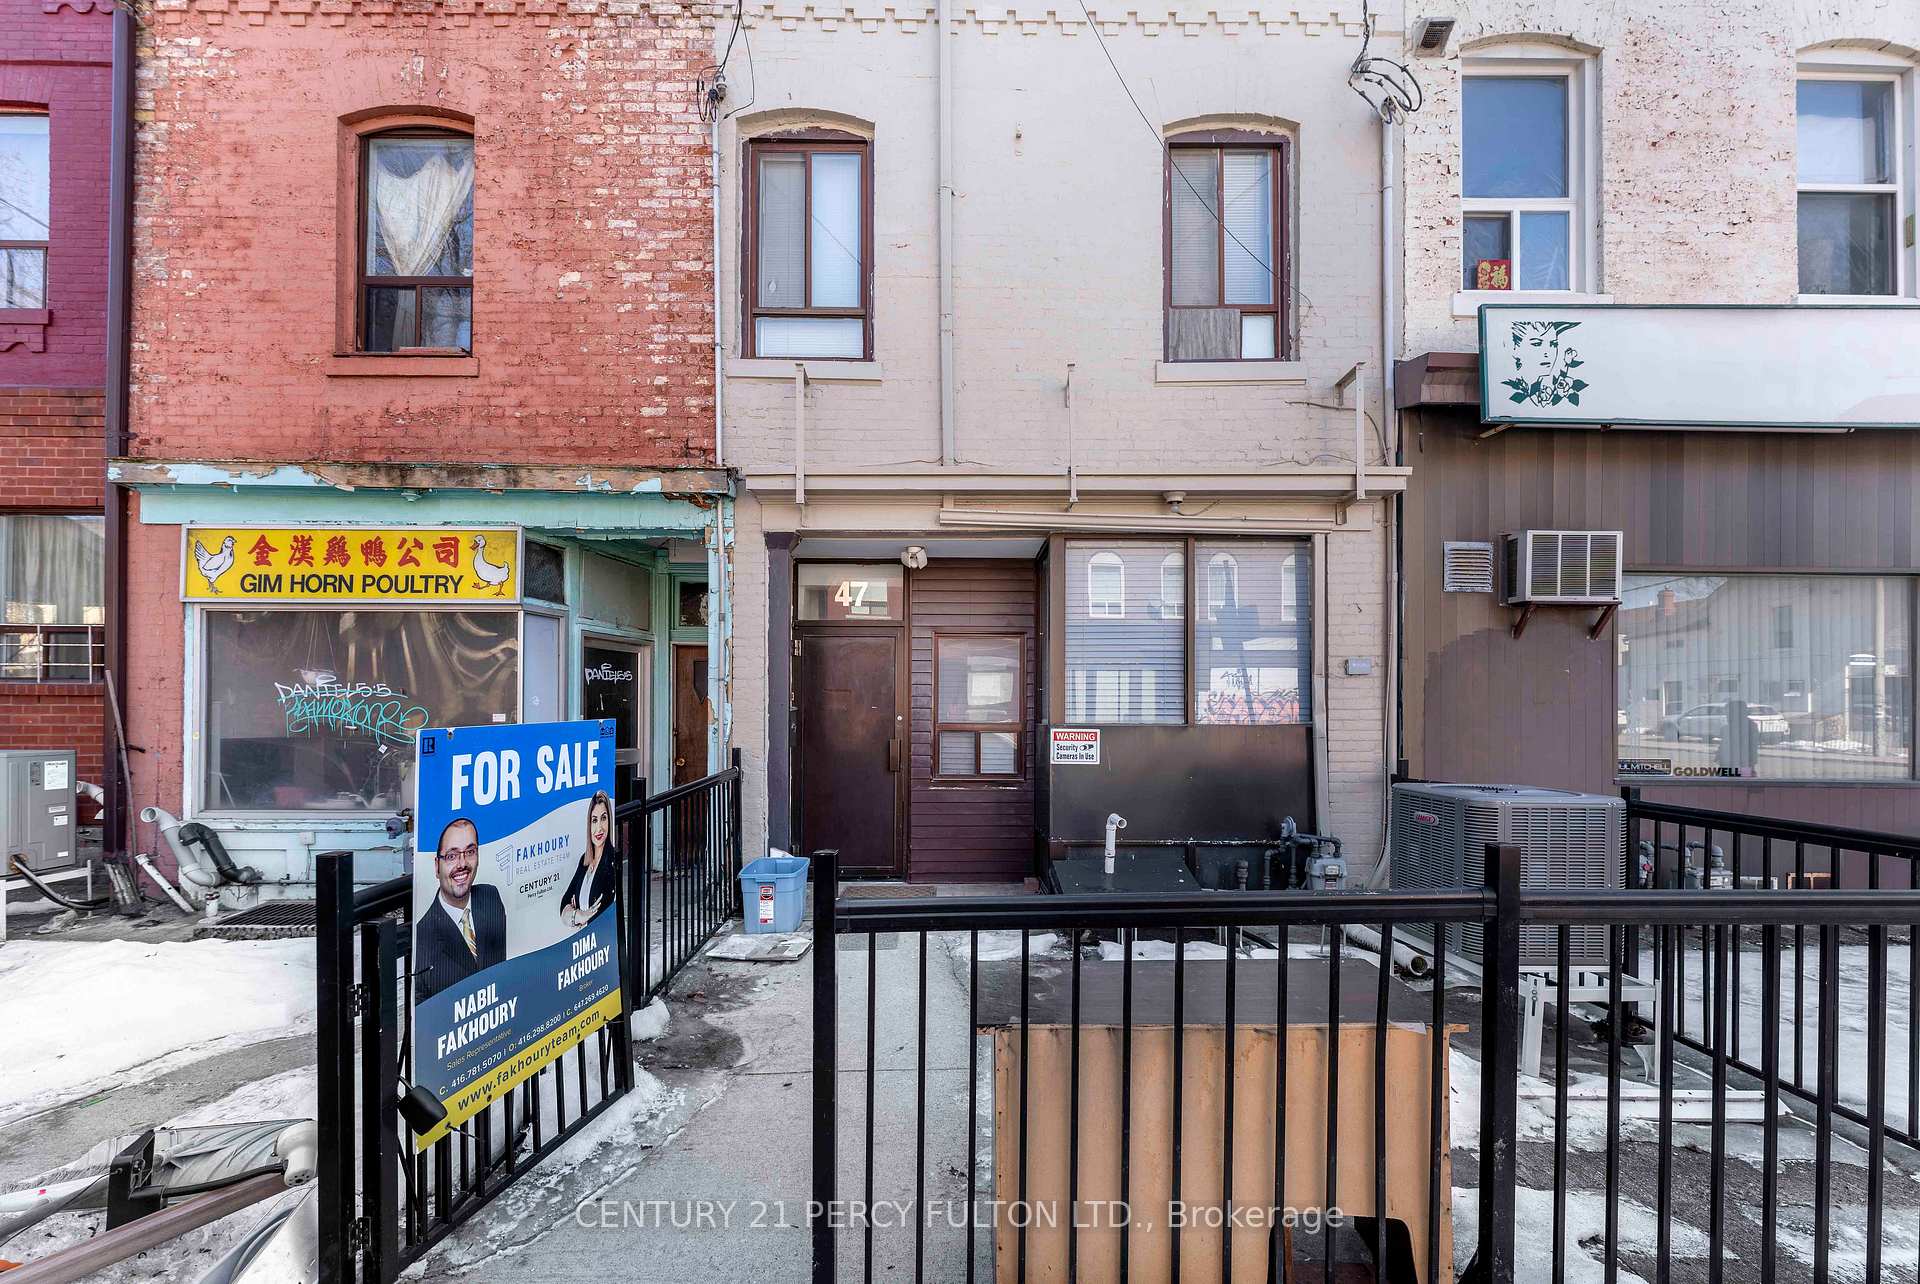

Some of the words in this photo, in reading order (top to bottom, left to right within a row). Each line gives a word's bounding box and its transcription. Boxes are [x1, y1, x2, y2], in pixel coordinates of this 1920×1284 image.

[240, 573, 283, 594] GIM
[290, 573, 354, 594] HORN
[362, 573, 464, 594] POULTRY
[834, 581, 869, 607] 47
[1055, 732, 1096, 741] WARNING
[1056, 743, 1078, 752] Security
[1056, 752, 1078, 760] Cameras
[1085, 752, 1095, 760] Use
[451, 749, 521, 811] FOR
[536, 740, 600, 794] SALE
[1673, 767, 1741, 777] GOLDWELL
[516, 834, 570, 862] FAKHOURY
[516, 864, 530, 875] REAL
[534, 856, 554, 870] ESTATE
[556, 851, 570, 862] TEAM
[519, 875, 553, 894] CENTURY
[553, 872, 560, 882] 21
[572, 932, 597, 960] DIMA
[557, 945, 610, 991] FAKHOURY
[578, 980, 593, 992] Broker
[454, 982, 499, 1024] NABIL
[437, 996, 518, 1060] FAKHOURY
[446, 1057, 466, 1071] Sales
[466, 1029, 512, 1058] Representative
[451, 1051, 502, 1088] 416.781.5070
[518, 1013, 561, 1046] 416.298.8200
[457, 1009, 600, 1112] www.fakhouryteam.com
